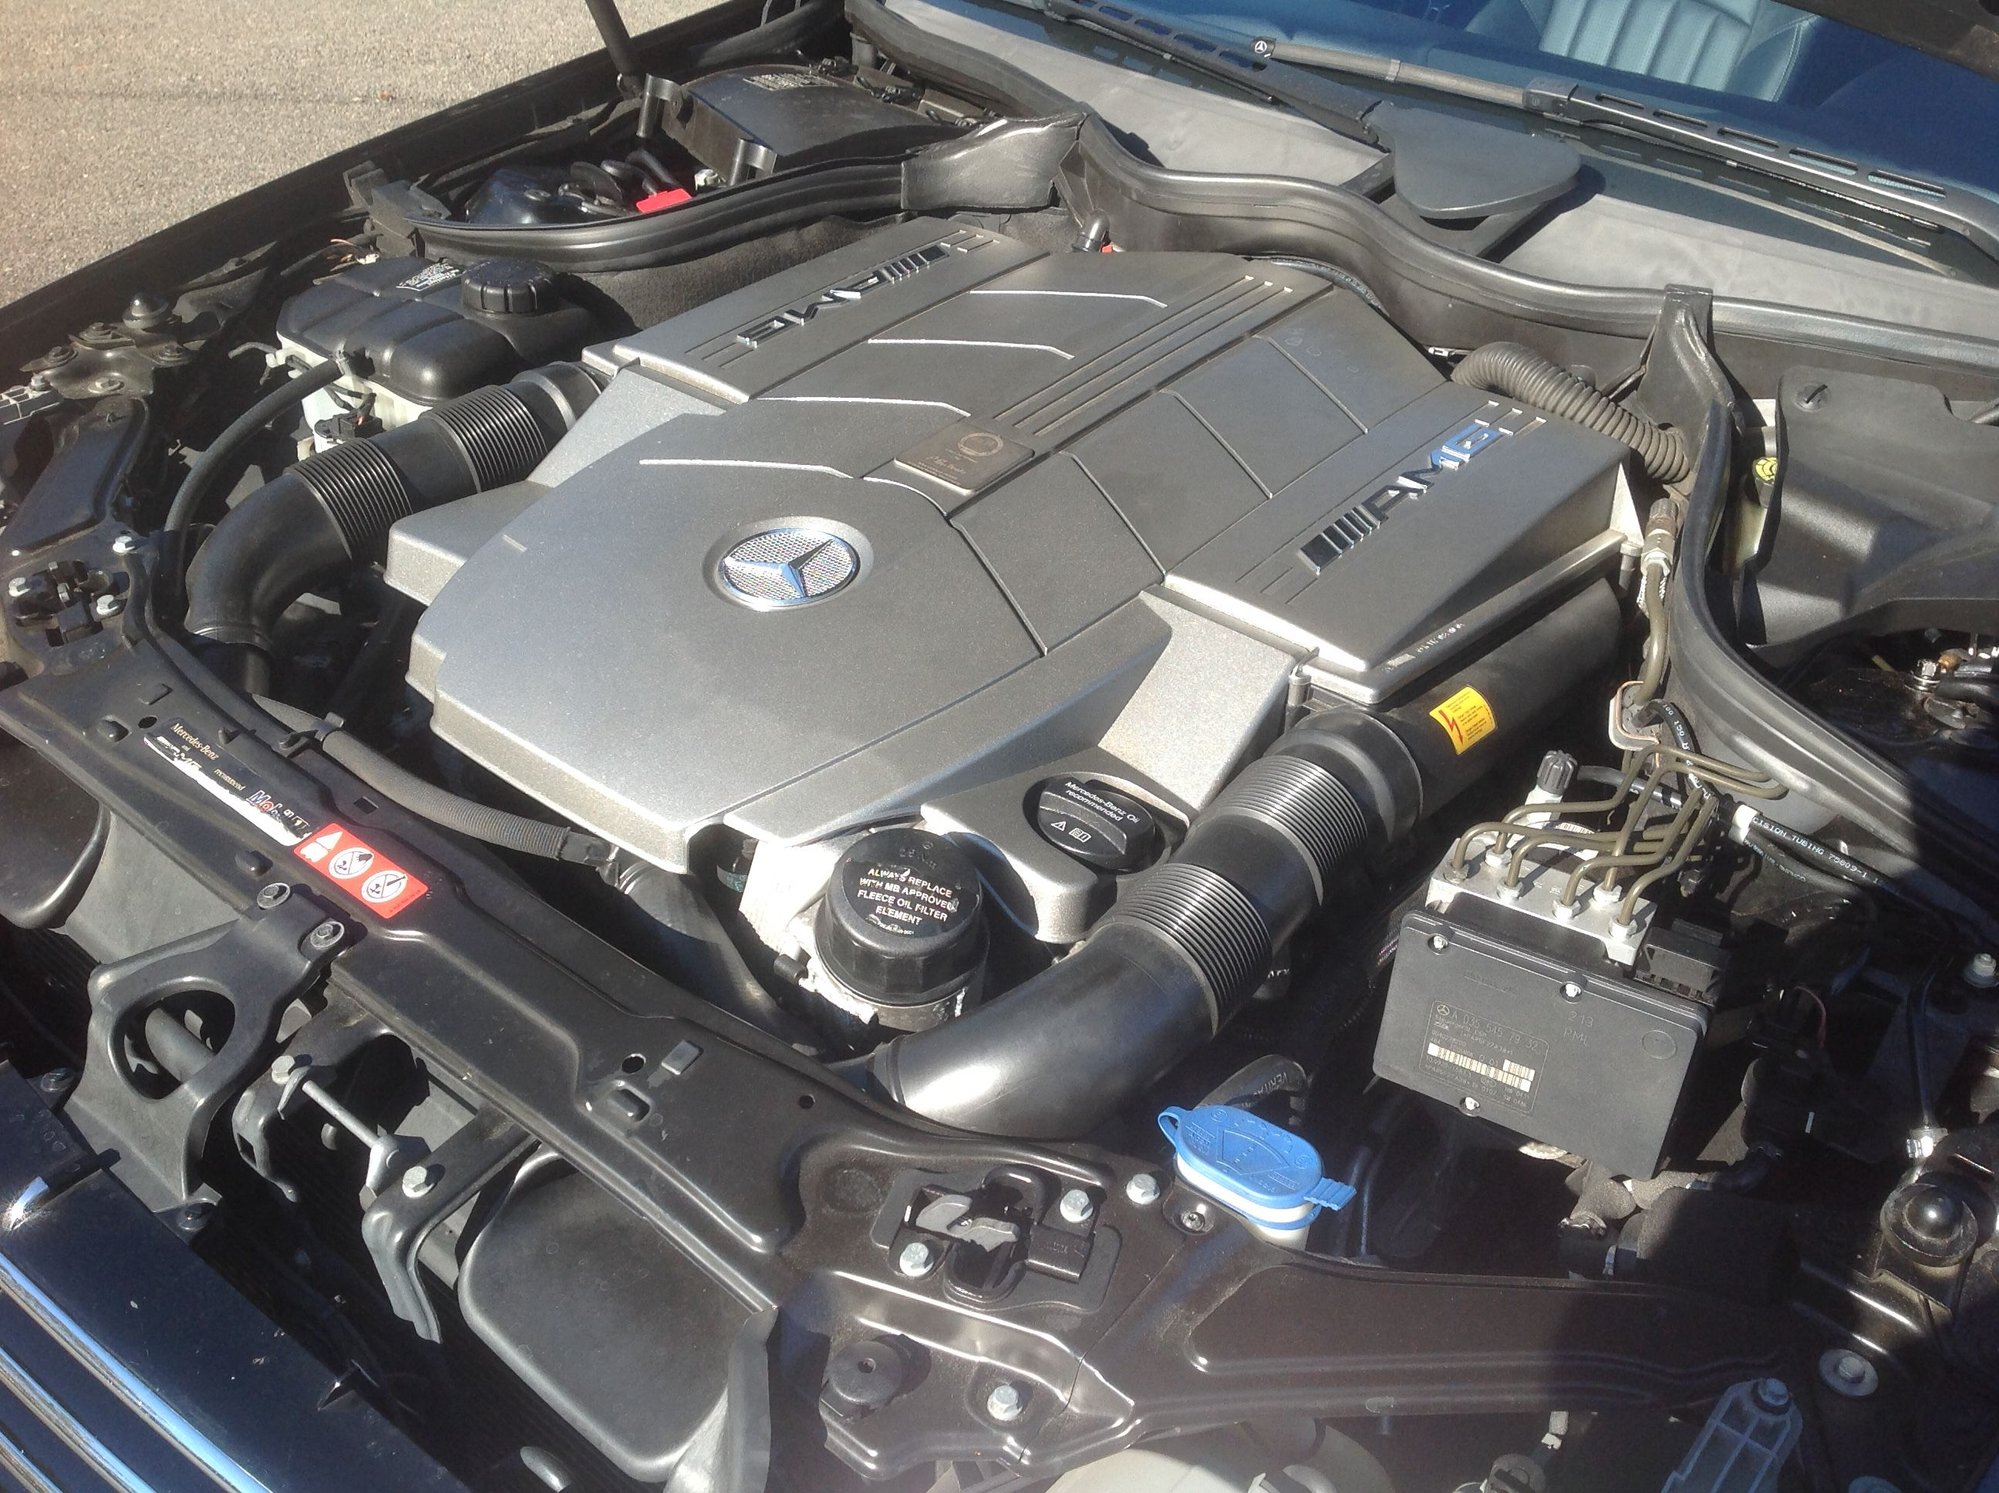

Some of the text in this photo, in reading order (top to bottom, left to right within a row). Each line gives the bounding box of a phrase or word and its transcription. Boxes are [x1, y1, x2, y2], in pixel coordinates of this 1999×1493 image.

[170, 722, 219, 761] Mercedes-Benz
[1064, 781, 1142, 824] Mercedes-Benz Oil
[1065, 789, 1124, 822] recommended
[1791, 834, 1825, 856] TUBING
[859, 877, 959, 912] WITH MB APPROVED
[867, 867, 953, 898] ALWAYS REPLACE
[857, 889, 948, 922] FLEECE OIL FILTER
[875, 905, 922, 926] ELEMENT
